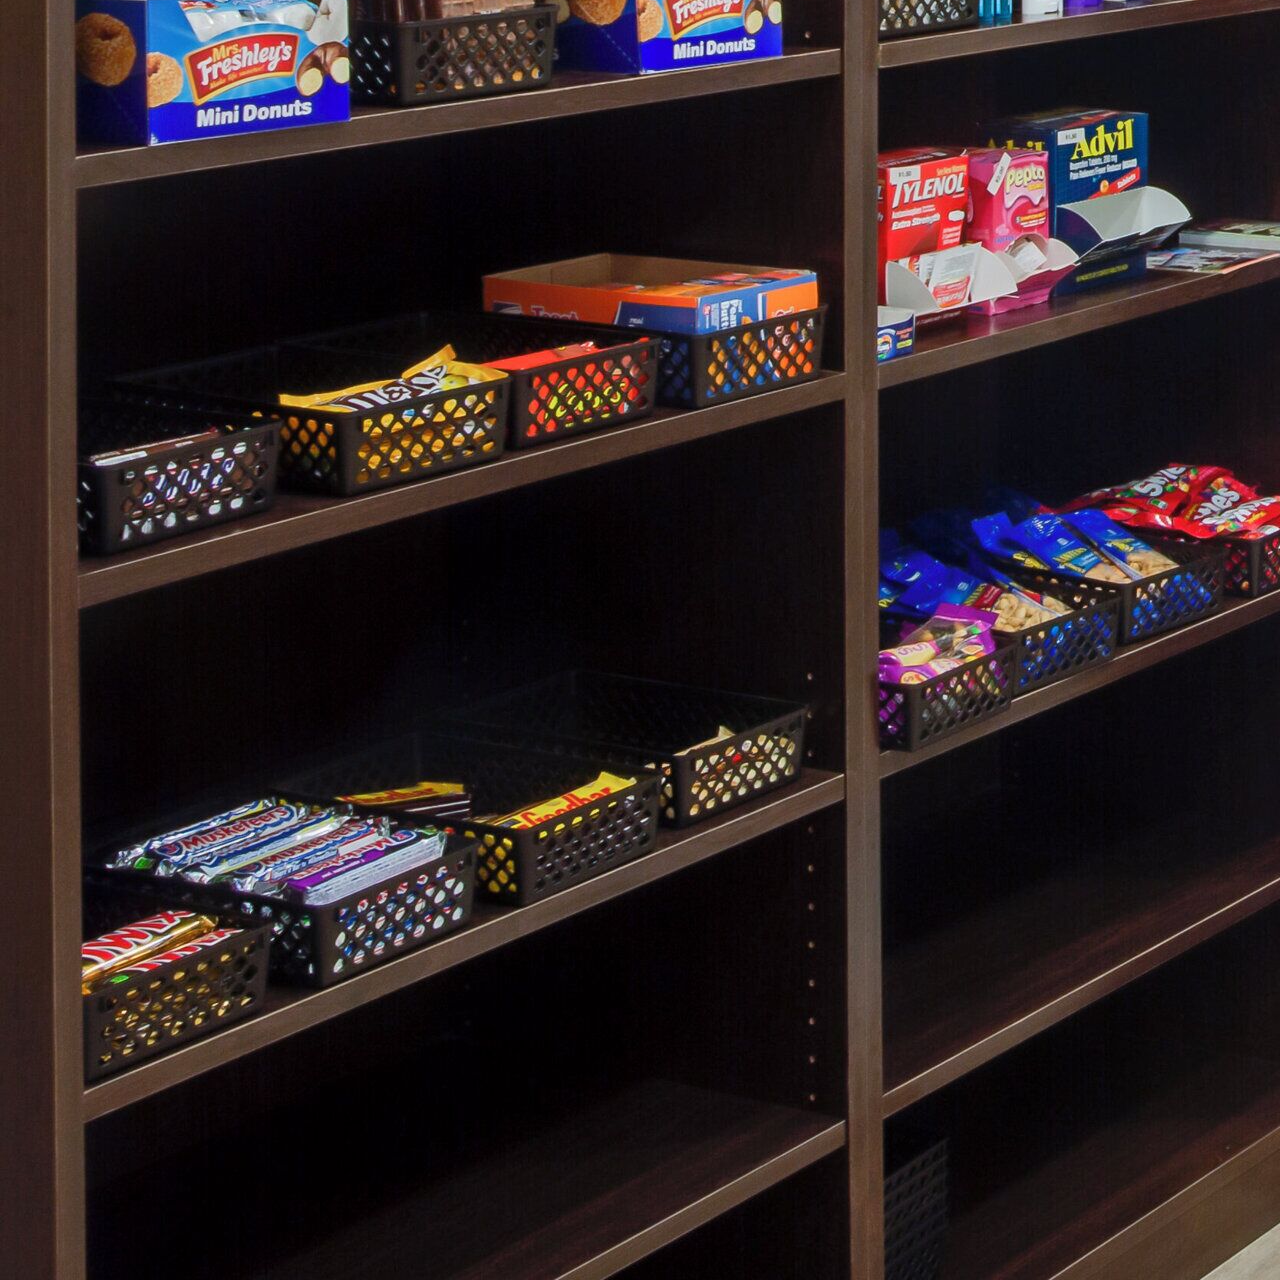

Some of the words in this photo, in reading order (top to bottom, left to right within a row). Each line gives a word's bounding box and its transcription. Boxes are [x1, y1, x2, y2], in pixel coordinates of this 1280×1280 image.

[196, 41, 293, 86] Freshley's
[673, 40, 705, 60] Mini
[706, 37, 756, 56] Donuts
[196, 105, 240, 128] Mini
[243, 100, 313, 123] Donuts
[1070, 118, 1134, 160] Advil
[890, 172, 965, 209] TYLENOL
[183, 806, 289, 851] Musketeers
